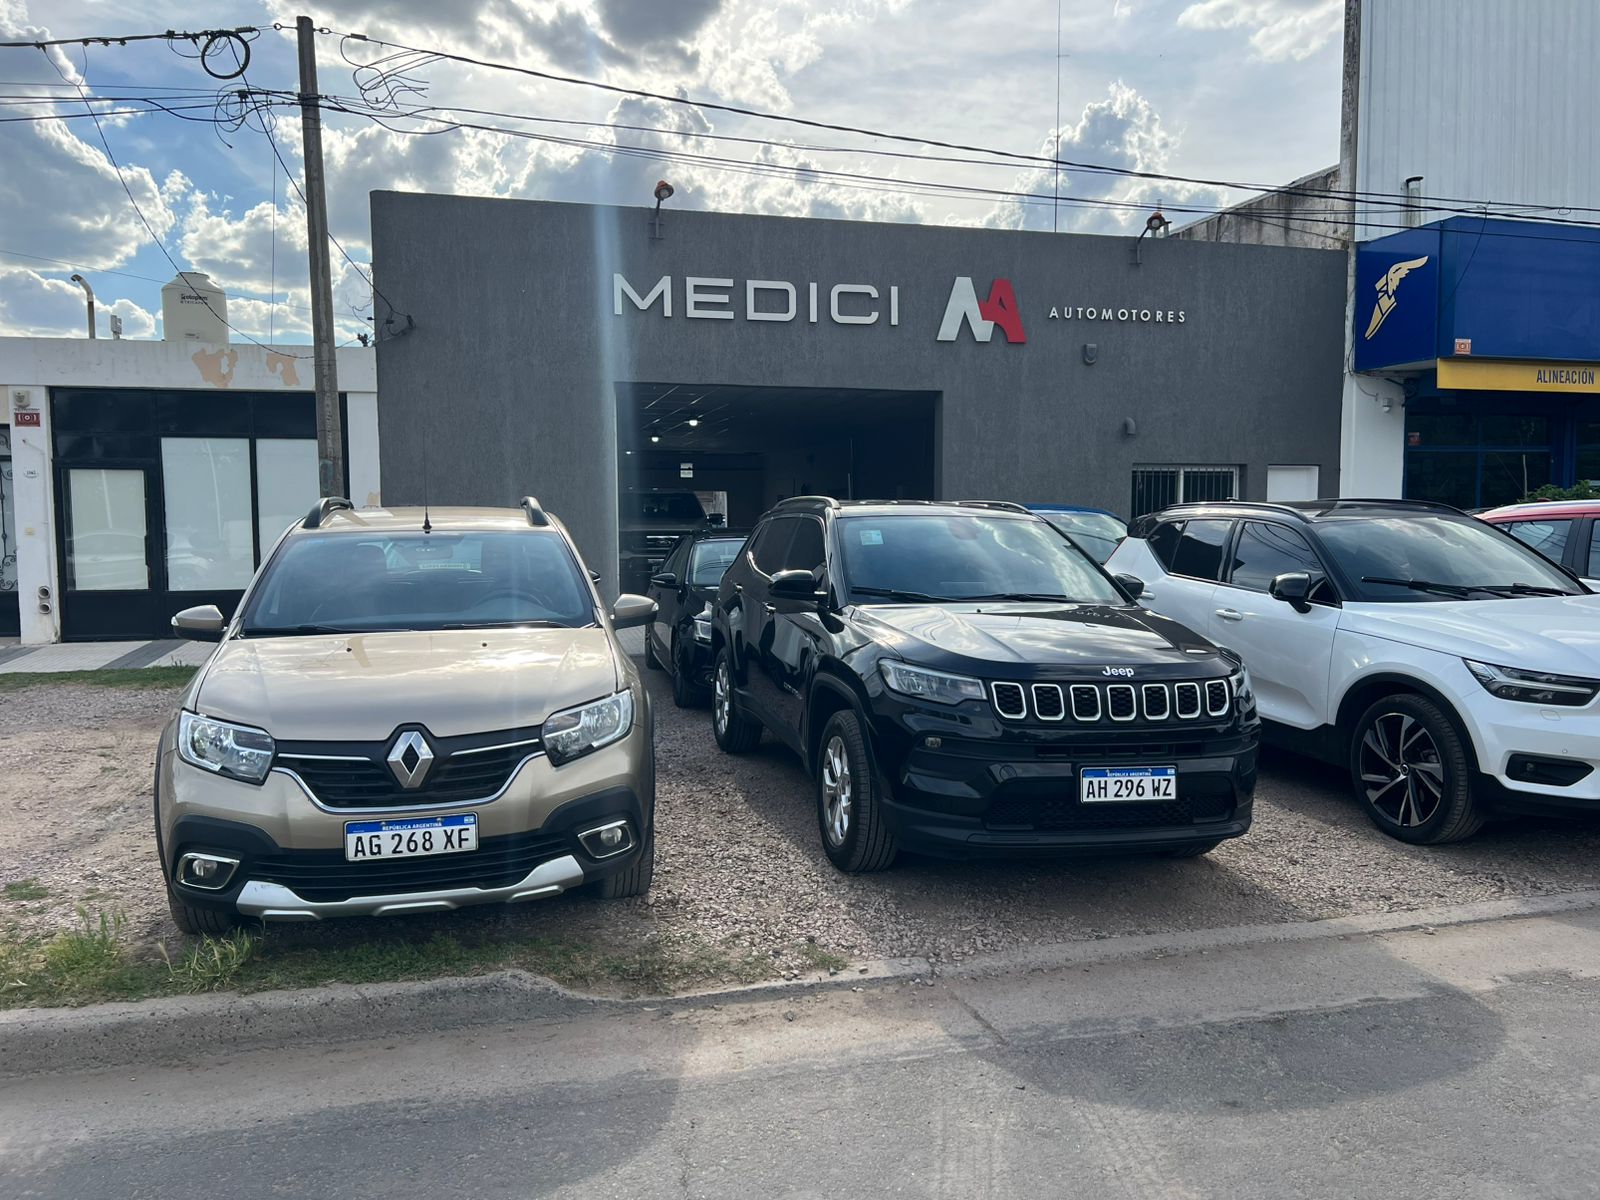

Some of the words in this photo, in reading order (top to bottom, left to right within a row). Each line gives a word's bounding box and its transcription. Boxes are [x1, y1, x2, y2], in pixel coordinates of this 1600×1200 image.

[613, 273, 899, 326] MEDICI
[1049, 307, 1187, 323] AUTOMOTORES
[1536, 367, 1595, 385] ALINEACIÓN
[1102, 665, 1135, 678] Jeep
[1086, 780, 1108, 799] AH
[1114, 779, 1146, 798] 296
[1152, 778, 1172, 797] WZ
[354, 835, 382, 857] AG
[391, 831, 433, 854] 268
[443, 828, 470, 850] XF
